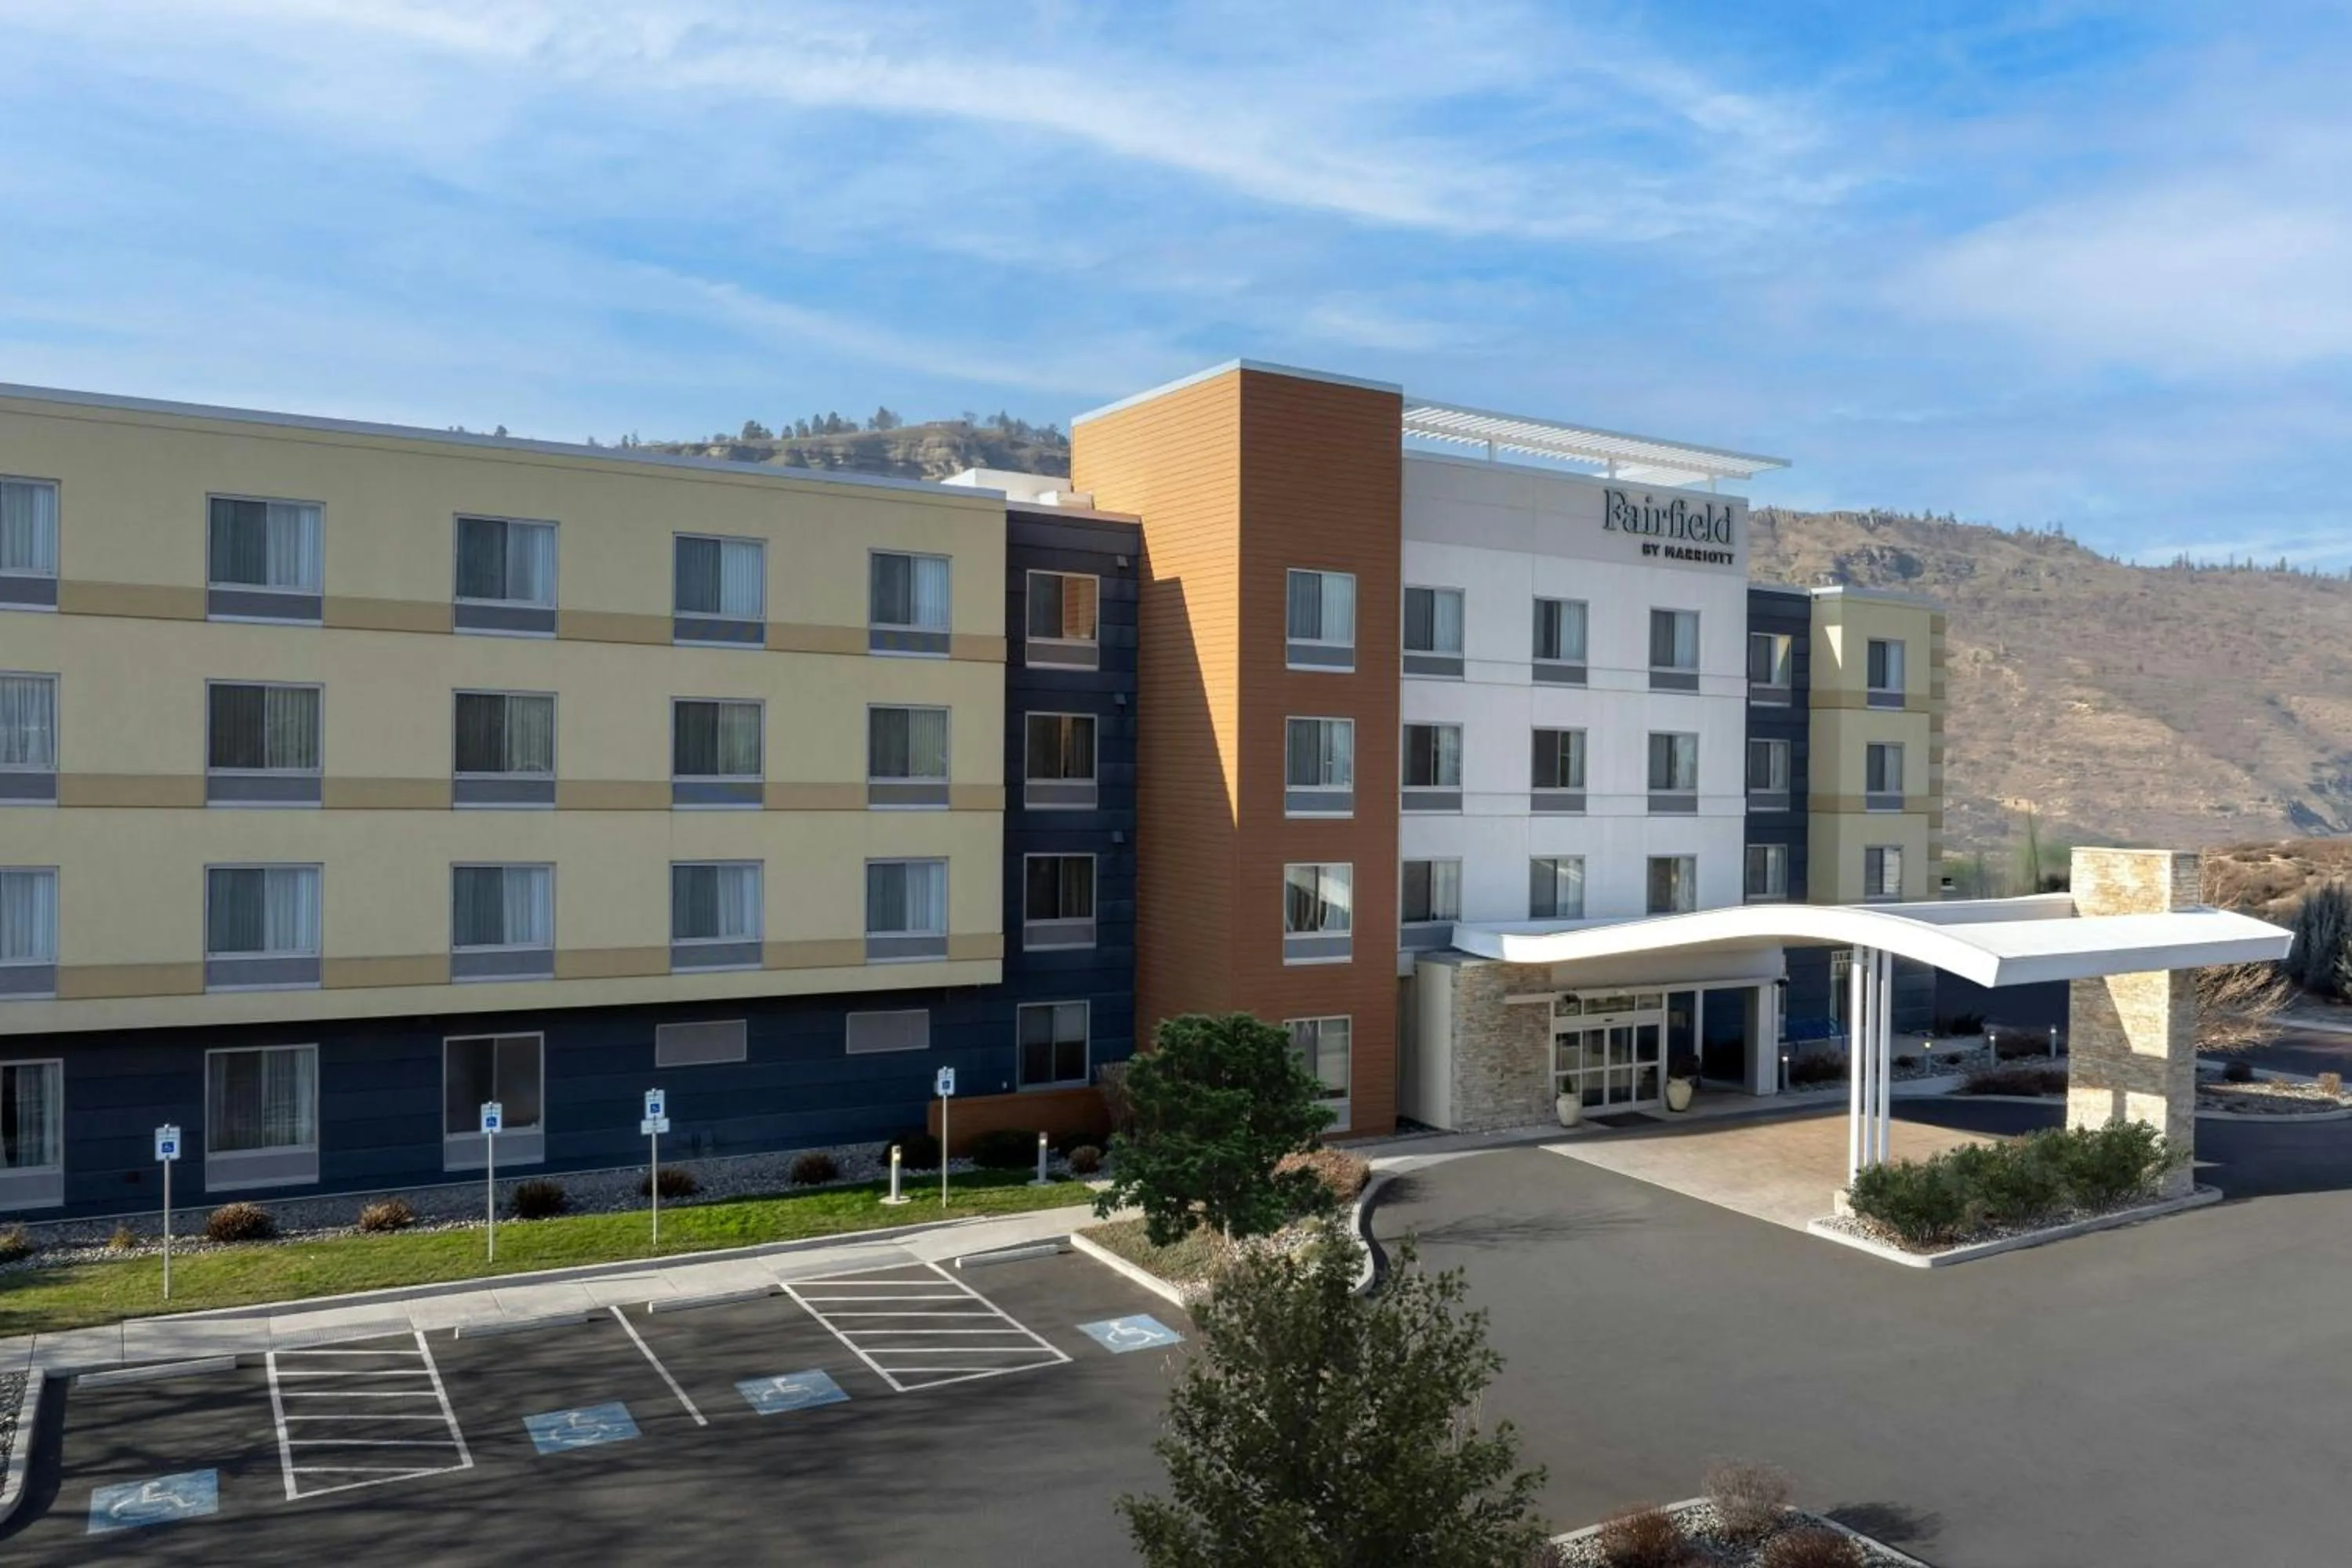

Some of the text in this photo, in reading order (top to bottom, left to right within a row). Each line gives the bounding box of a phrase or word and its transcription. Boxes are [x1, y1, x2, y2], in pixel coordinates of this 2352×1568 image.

[1603, 488, 1734, 545] Fairfield
[1642, 543, 1735, 564] BY MARRIOTT
